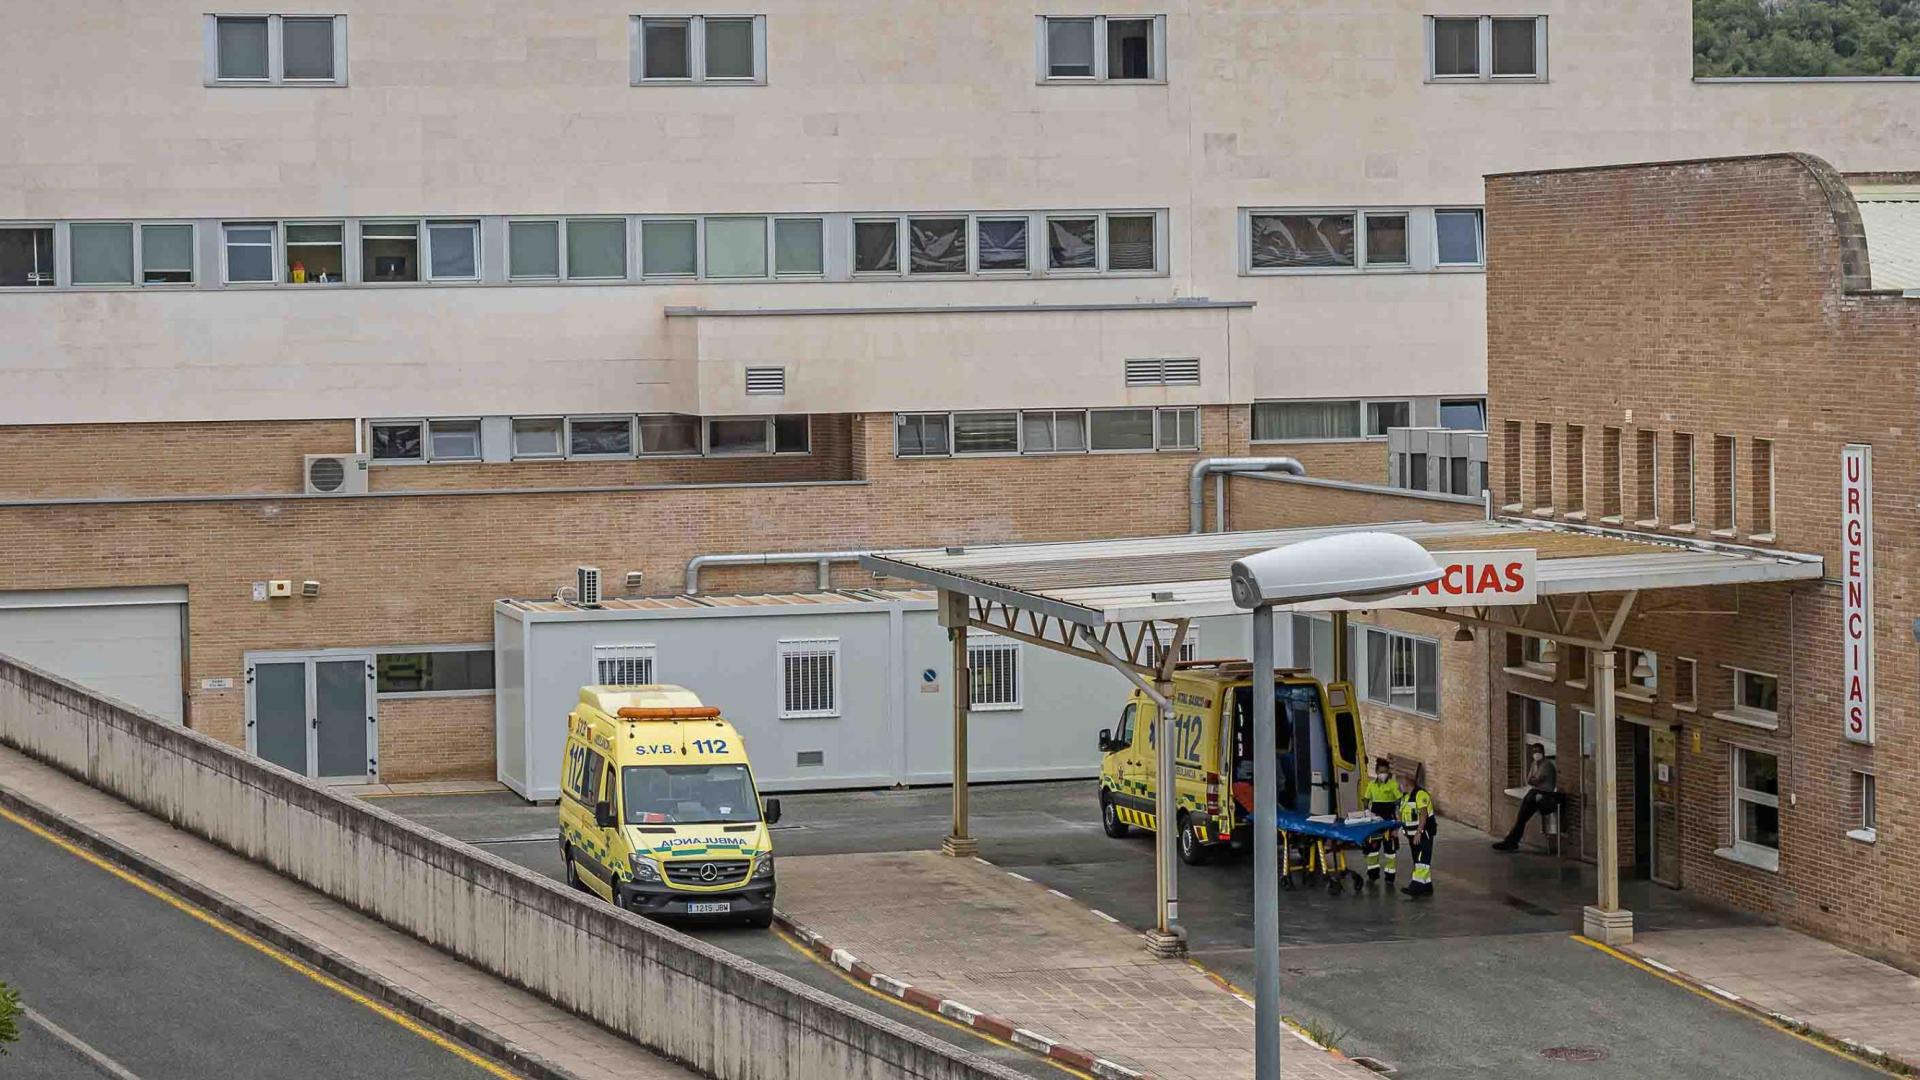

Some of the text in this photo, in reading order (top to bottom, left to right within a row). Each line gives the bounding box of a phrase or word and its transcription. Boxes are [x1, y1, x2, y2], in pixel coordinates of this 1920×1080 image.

[1847, 456, 1863, 734] URGENCIAS
[636, 740, 729, 755] S.V.B. 112
[1175, 713, 1203, 762] 112
[568, 742, 585, 793] 112
